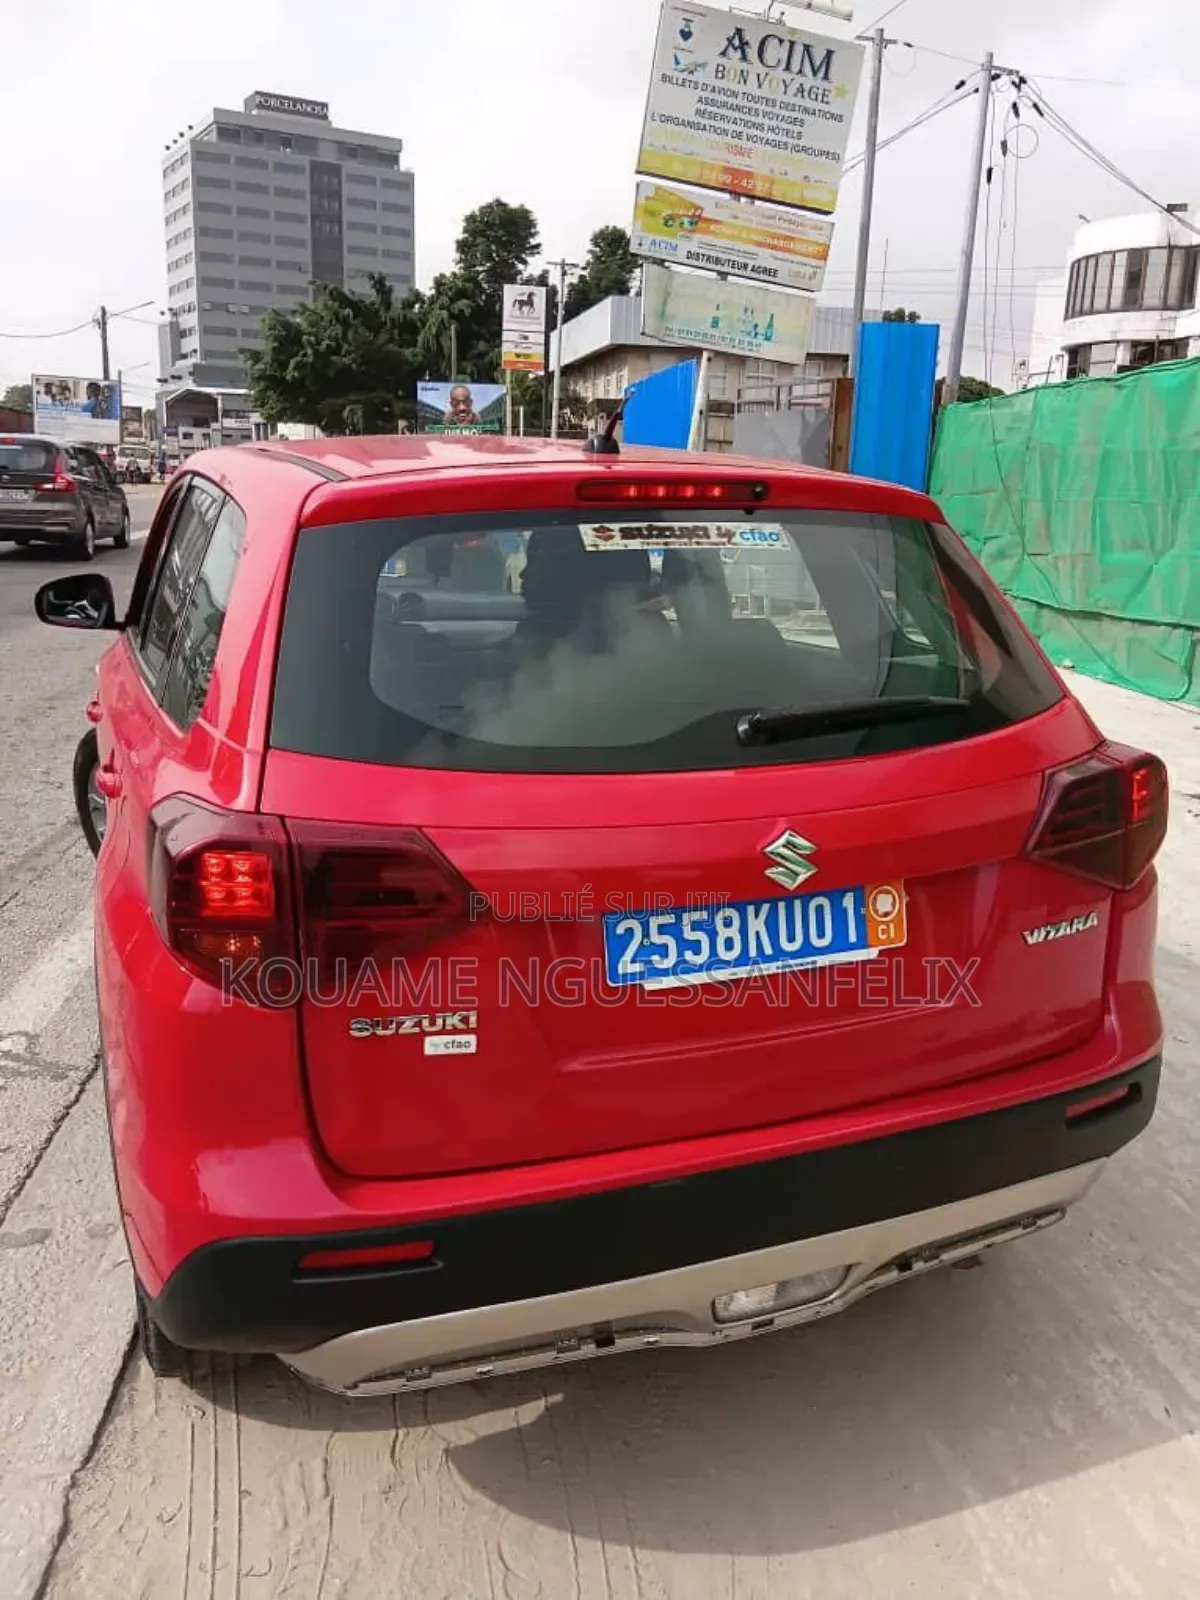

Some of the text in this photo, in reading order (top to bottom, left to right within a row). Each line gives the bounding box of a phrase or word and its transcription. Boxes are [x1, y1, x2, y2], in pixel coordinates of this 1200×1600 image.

[716, 26, 835, 82] ACIM
[661, 73, 844, 123] BILLETS D'AVION TOUTES DESTINATIONS
[714, 63, 832, 104] BON VOYAGE
[694, 107, 764, 132] RÉSERVATIONS
[696, 96, 805, 127] ASSURANCES VOYAGES
[650, 112, 840, 163] L'ORGANISATION DE VOYAGES (GROUPES)
[686, 250, 749, 273] DISTRIBUTEUR
[750, 263, 779, 279] AGREE
[615, 892, 857, 975] 2558KU01
[877, 924, 896, 940] CI
[1022, 912, 1098, 945] VITARA
[349, 1010, 477, 1037] SUZUKI
[443, 1039, 471, 1049] cfao
